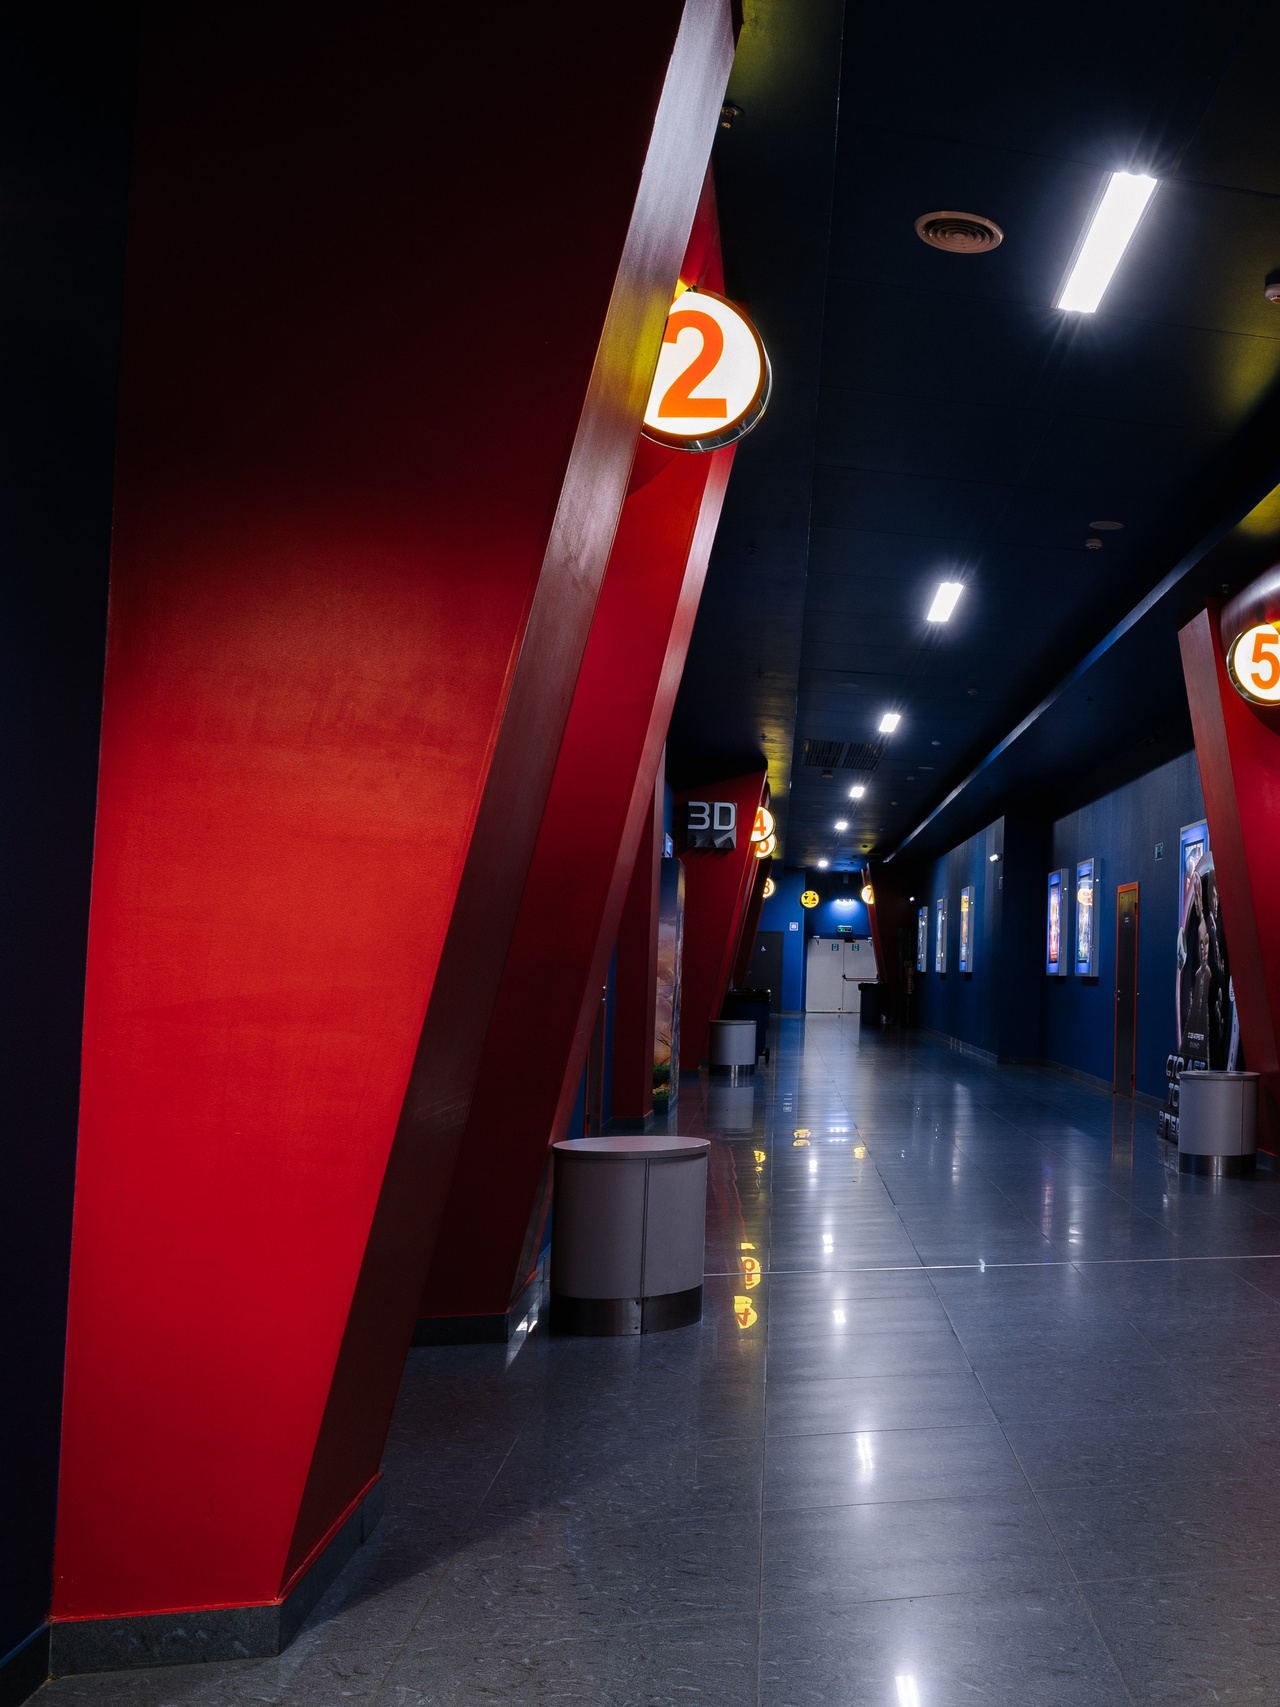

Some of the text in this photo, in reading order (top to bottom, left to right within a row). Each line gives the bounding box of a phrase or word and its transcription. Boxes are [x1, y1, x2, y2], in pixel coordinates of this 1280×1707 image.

[658, 309, 728, 418] 2
[1250, 633, 1280, 690] 5
[687, 801, 736, 831] 3D
[753, 810, 767, 836] 4
